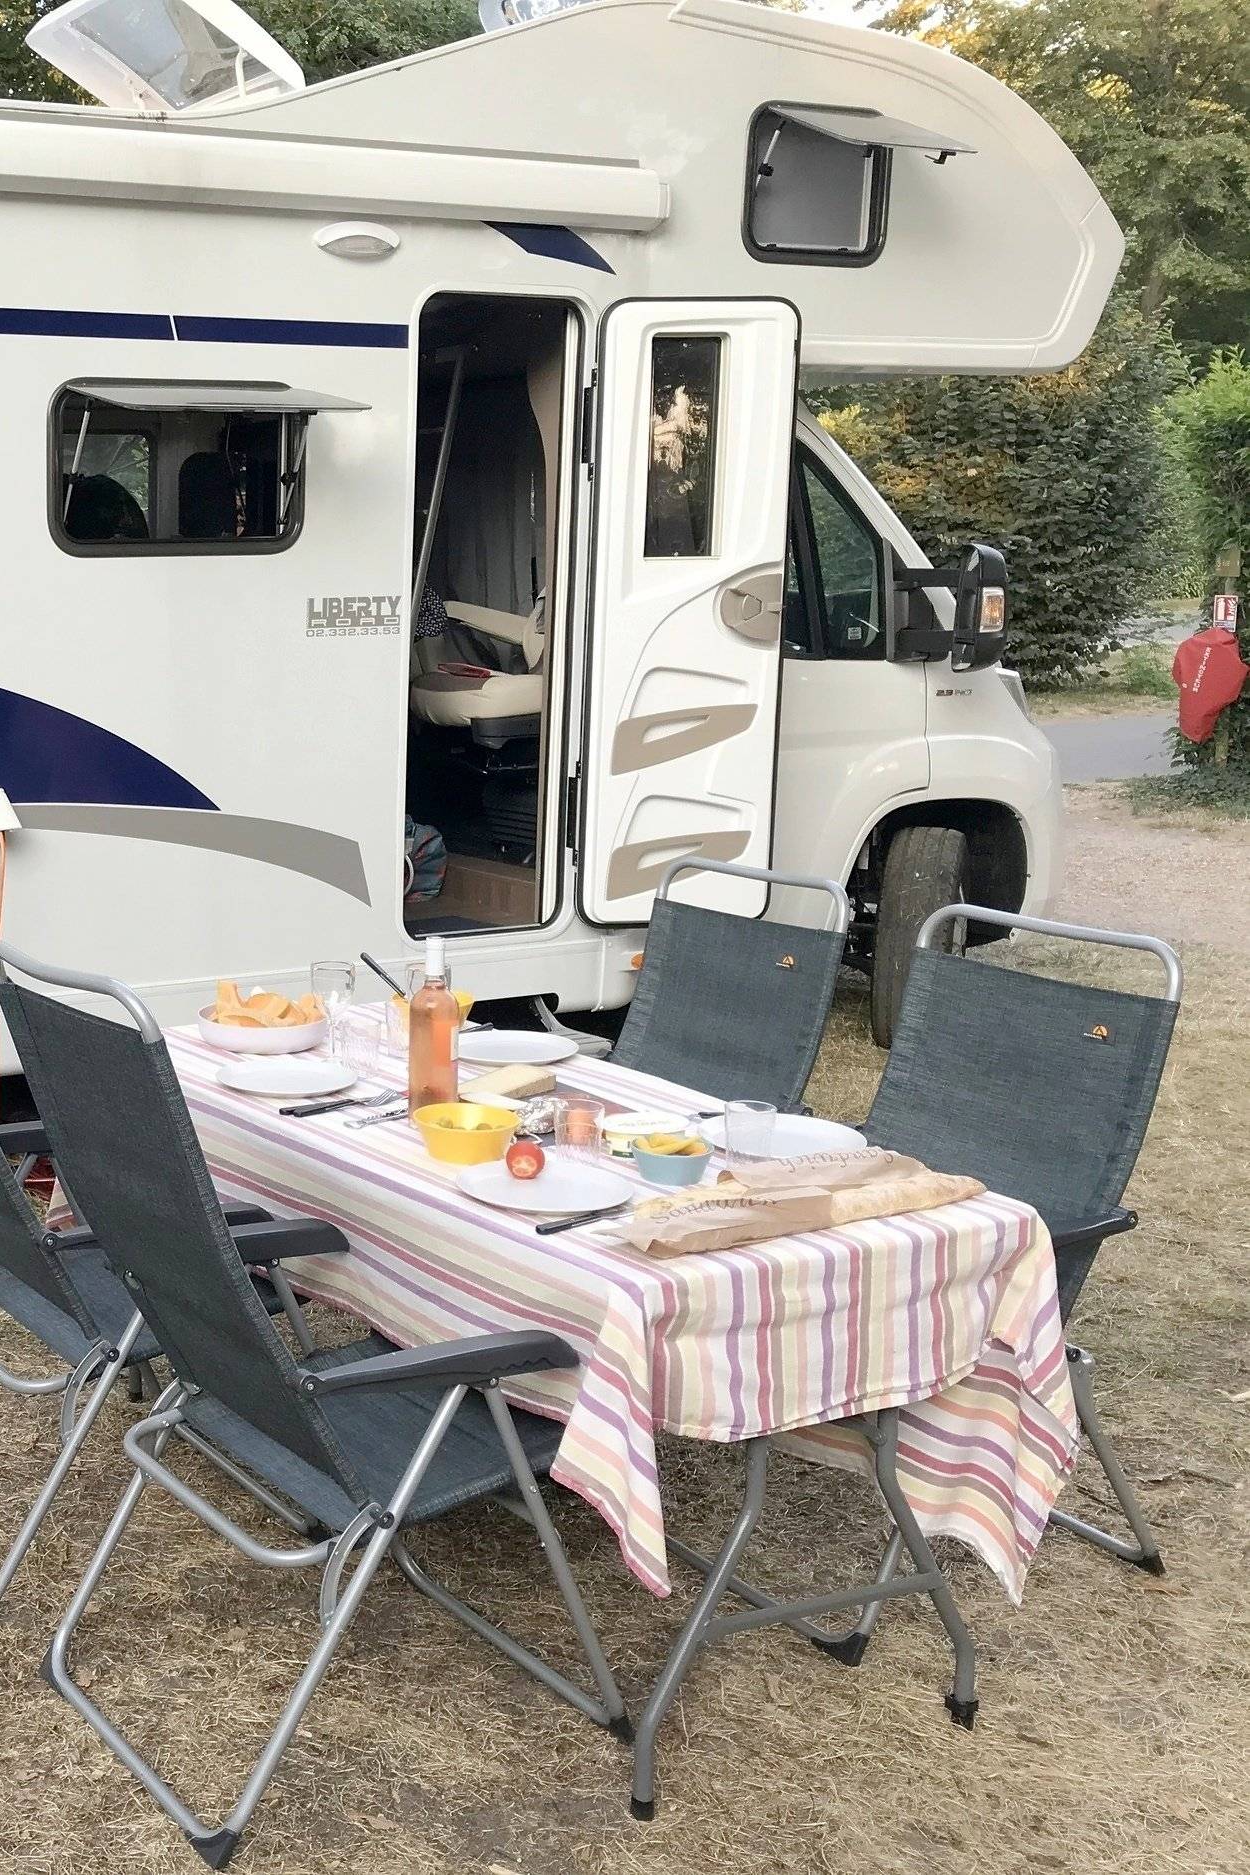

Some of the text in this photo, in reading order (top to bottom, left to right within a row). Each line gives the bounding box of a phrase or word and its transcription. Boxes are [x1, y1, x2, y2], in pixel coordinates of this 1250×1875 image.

[307, 595, 402, 617] LIBERTY
[311, 616, 399, 627] ROAD
[306, 626, 401, 638] 02.332.33.53
